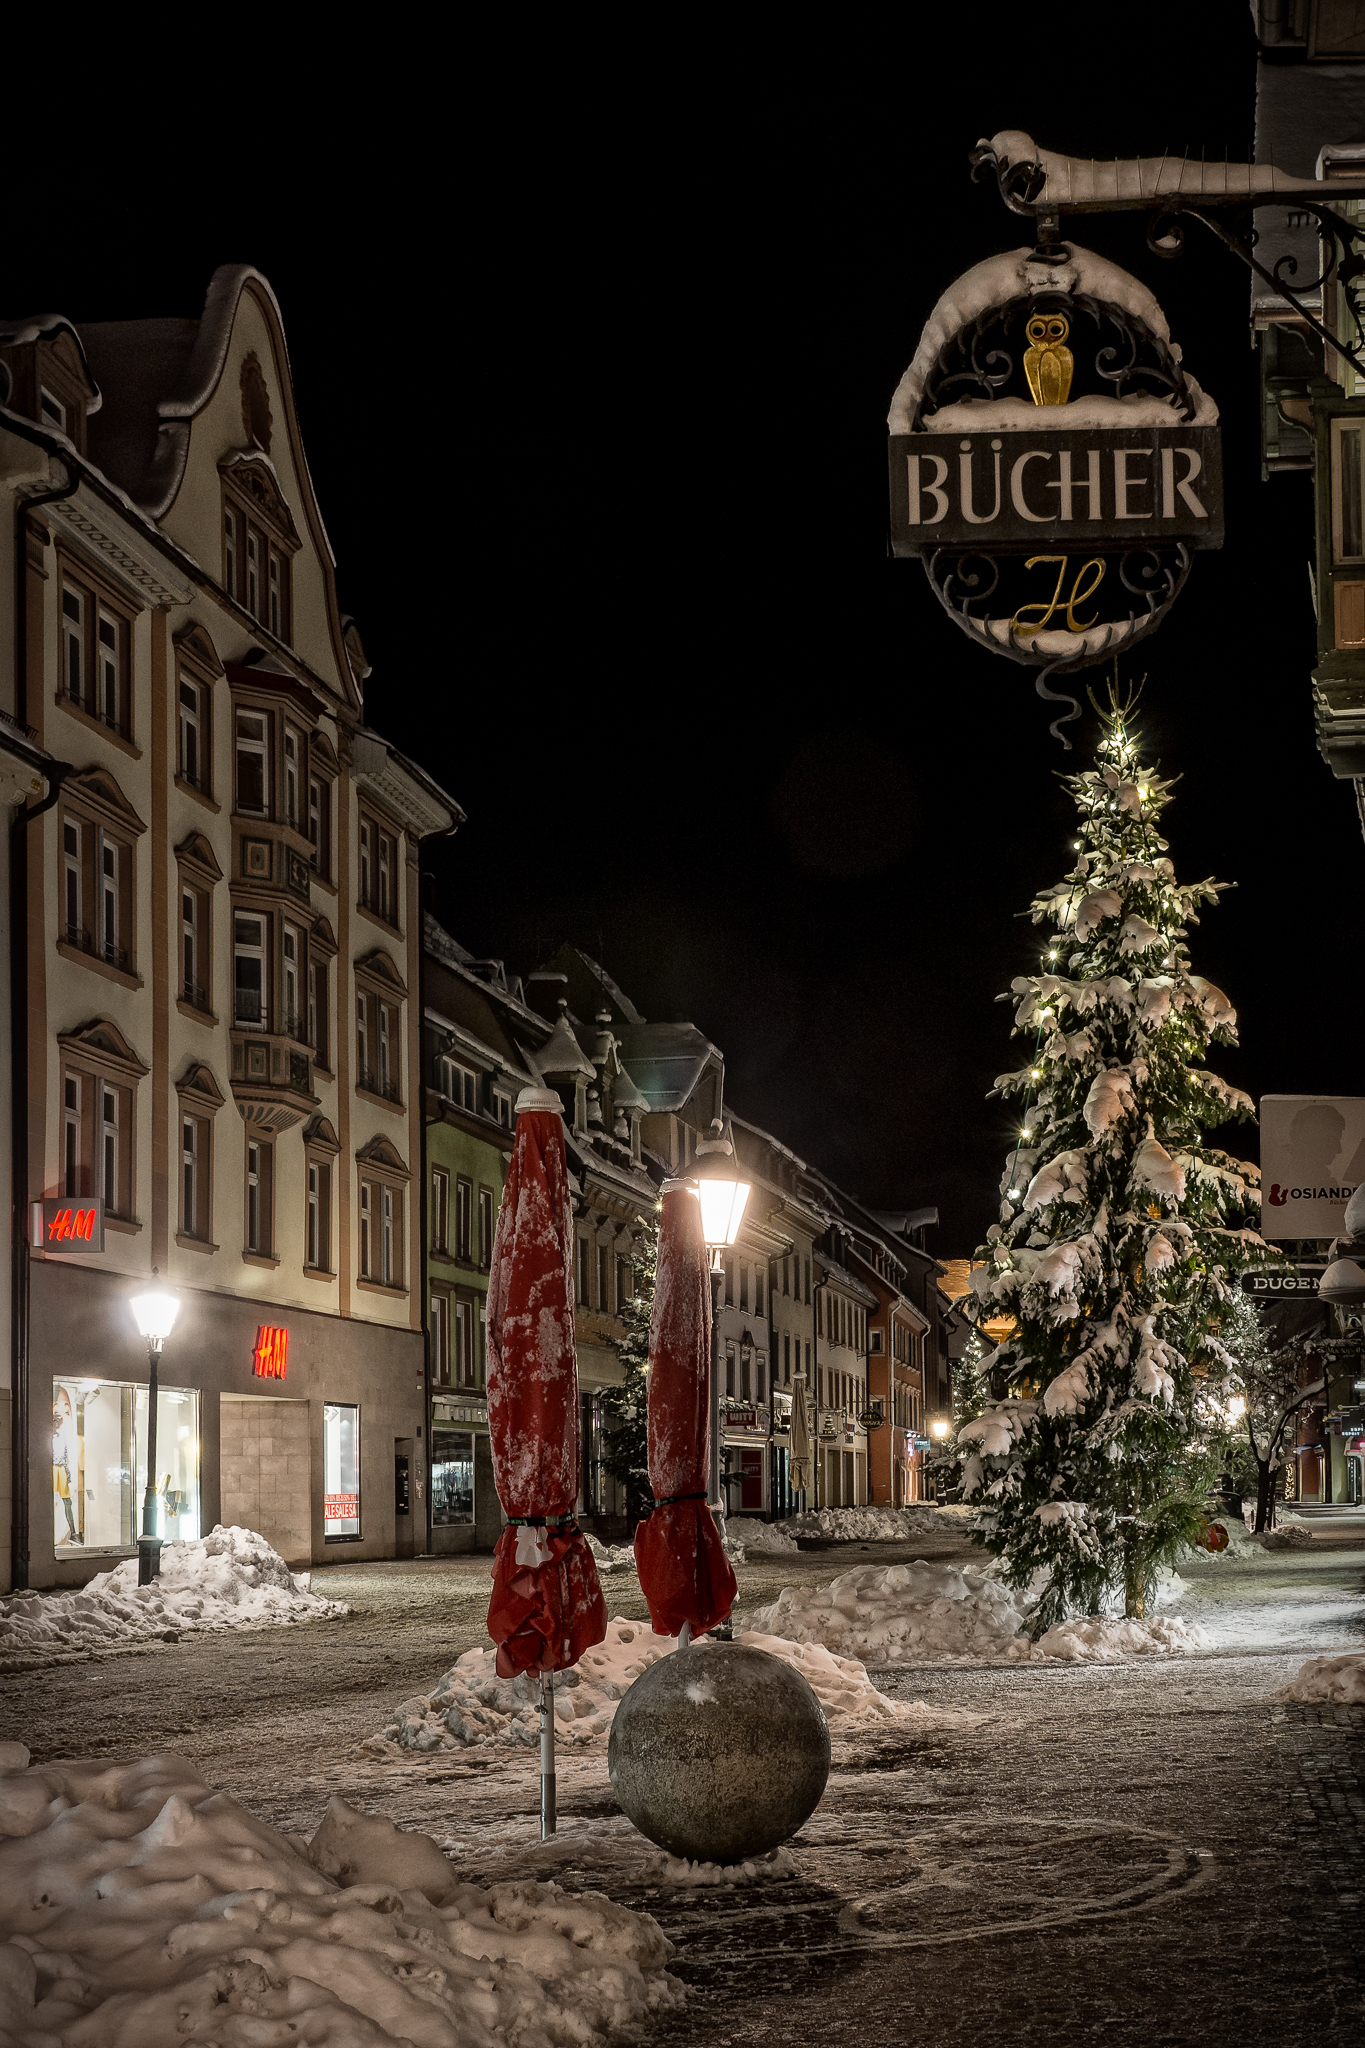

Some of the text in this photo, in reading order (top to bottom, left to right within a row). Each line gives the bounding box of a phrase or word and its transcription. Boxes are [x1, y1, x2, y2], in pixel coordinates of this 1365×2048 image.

[906, 438, 1209, 525] BÜCHER
[48, 1208, 97, 1242] H&M
[253, 1325, 289, 1381] H&M
[729, 1412, 754, 1422] WITT
